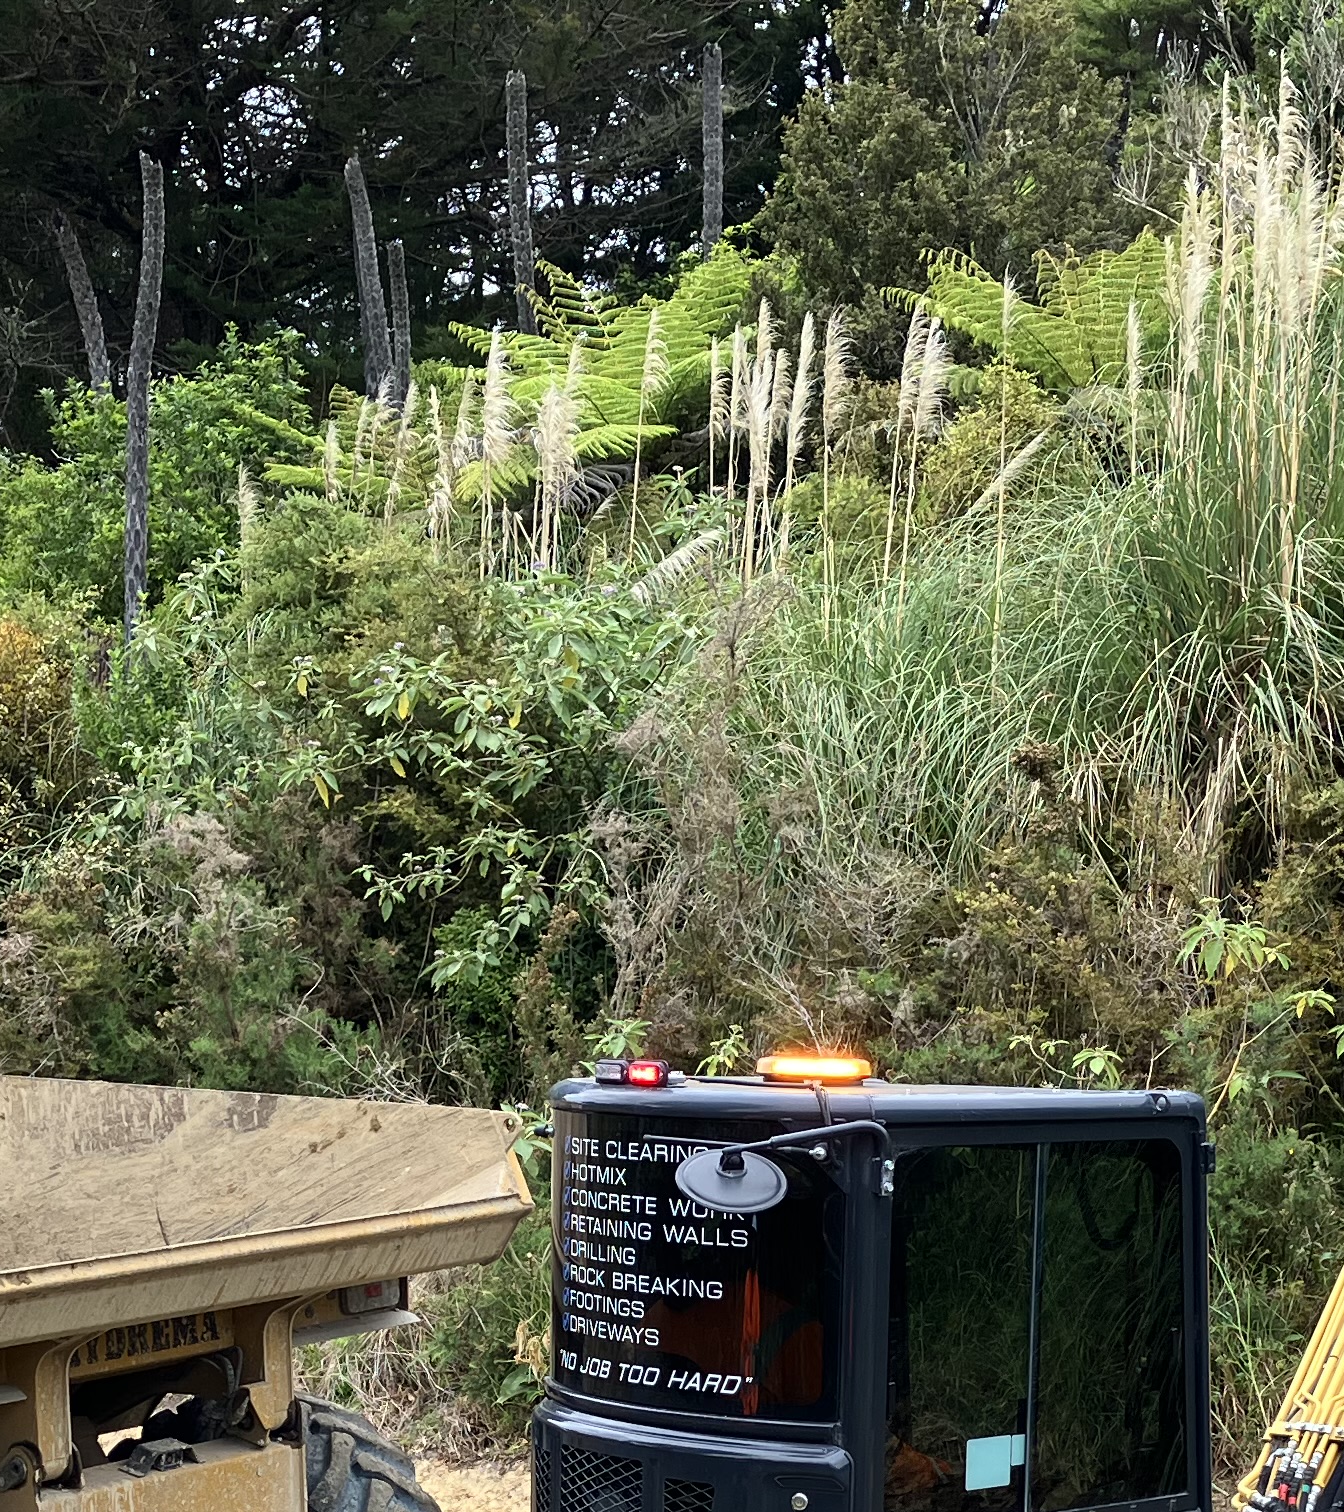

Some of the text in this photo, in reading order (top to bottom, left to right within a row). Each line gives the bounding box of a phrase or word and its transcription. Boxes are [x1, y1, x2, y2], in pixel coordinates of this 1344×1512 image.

[571, 1136, 599, 1157] SITE
[571, 1162, 627, 1186] HOTMIX
[571, 1188, 658, 1215] CONCRETE
[570, 1213, 749, 1248] RETAINING WALLS
[570, 1238, 636, 1266] DRILLING
[569, 1264, 724, 1300] ROCK BREAKING
[569, 1289, 645, 1319] FOOTINGS
[569, 1314, 660, 1346] DRIVEWAYS
[579, 1356, 612, 1379] JOB
[618, 1362, 661, 1386] TOO
